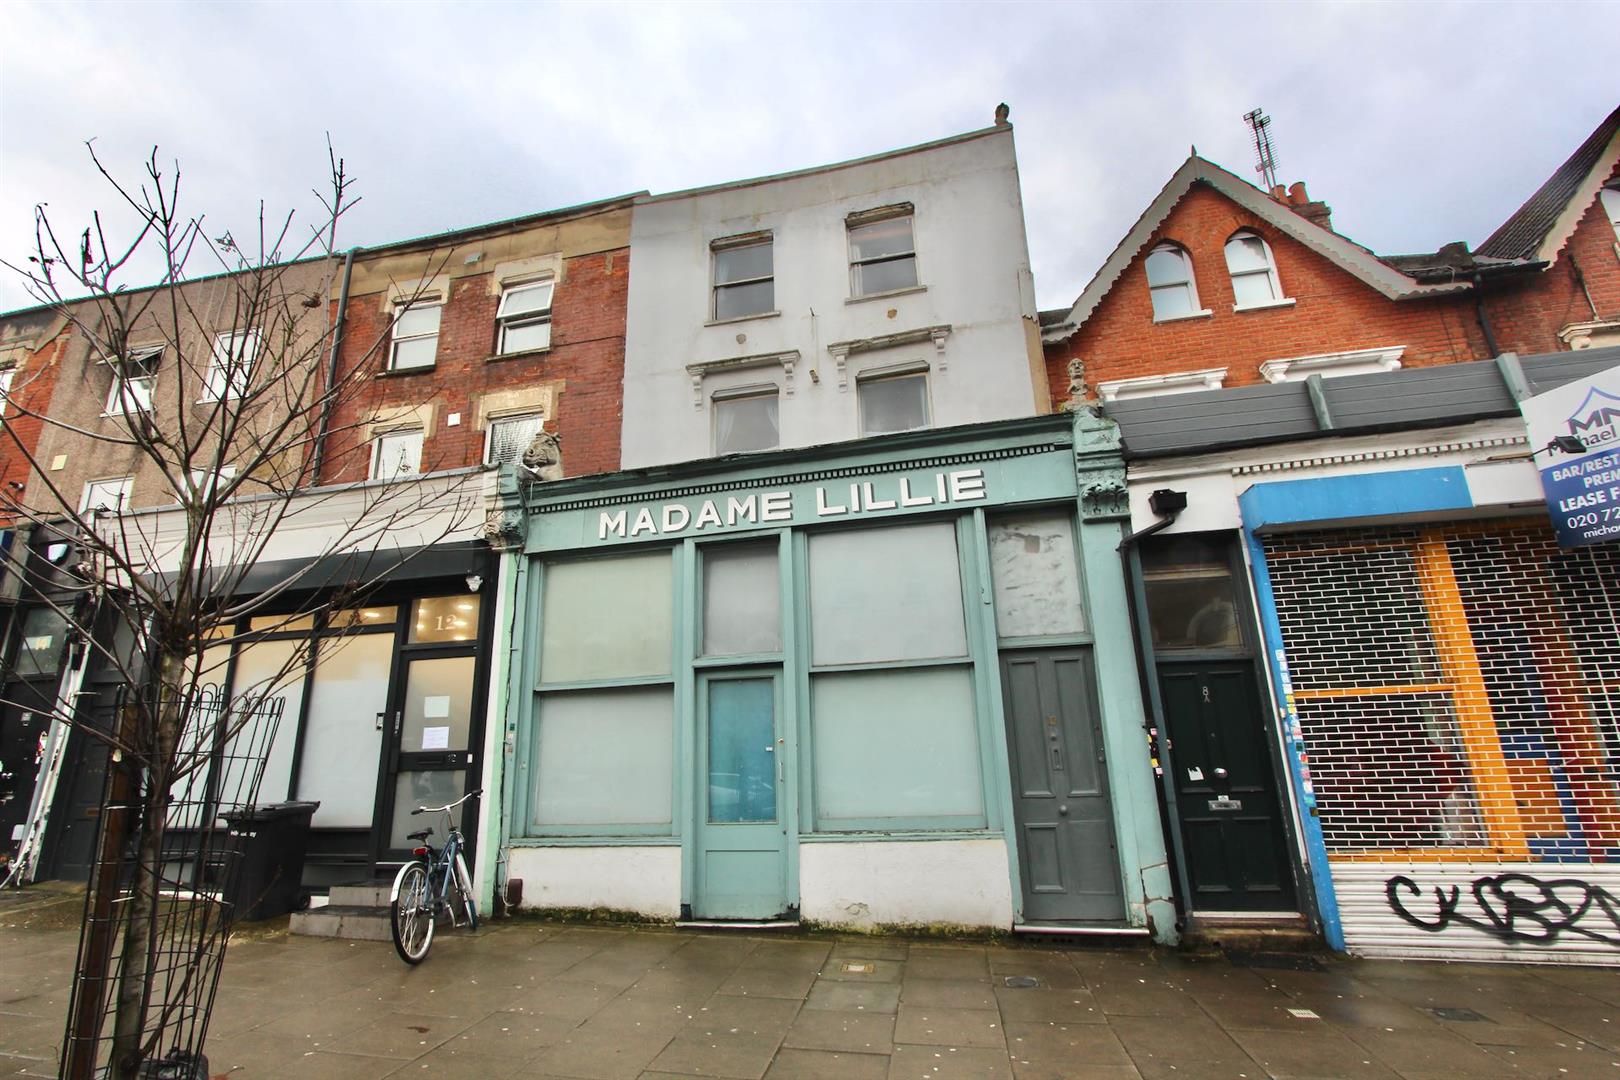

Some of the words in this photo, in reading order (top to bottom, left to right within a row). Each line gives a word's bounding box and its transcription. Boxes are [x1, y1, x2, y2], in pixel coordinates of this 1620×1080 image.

[599, 490, 794, 540] MADAME
[815, 468, 988, 517] LILLIE
[1559, 490, 1607, 513] LEASE
[1567, 512, 1598, 529] 020
[434, 614, 457, 631] 12
